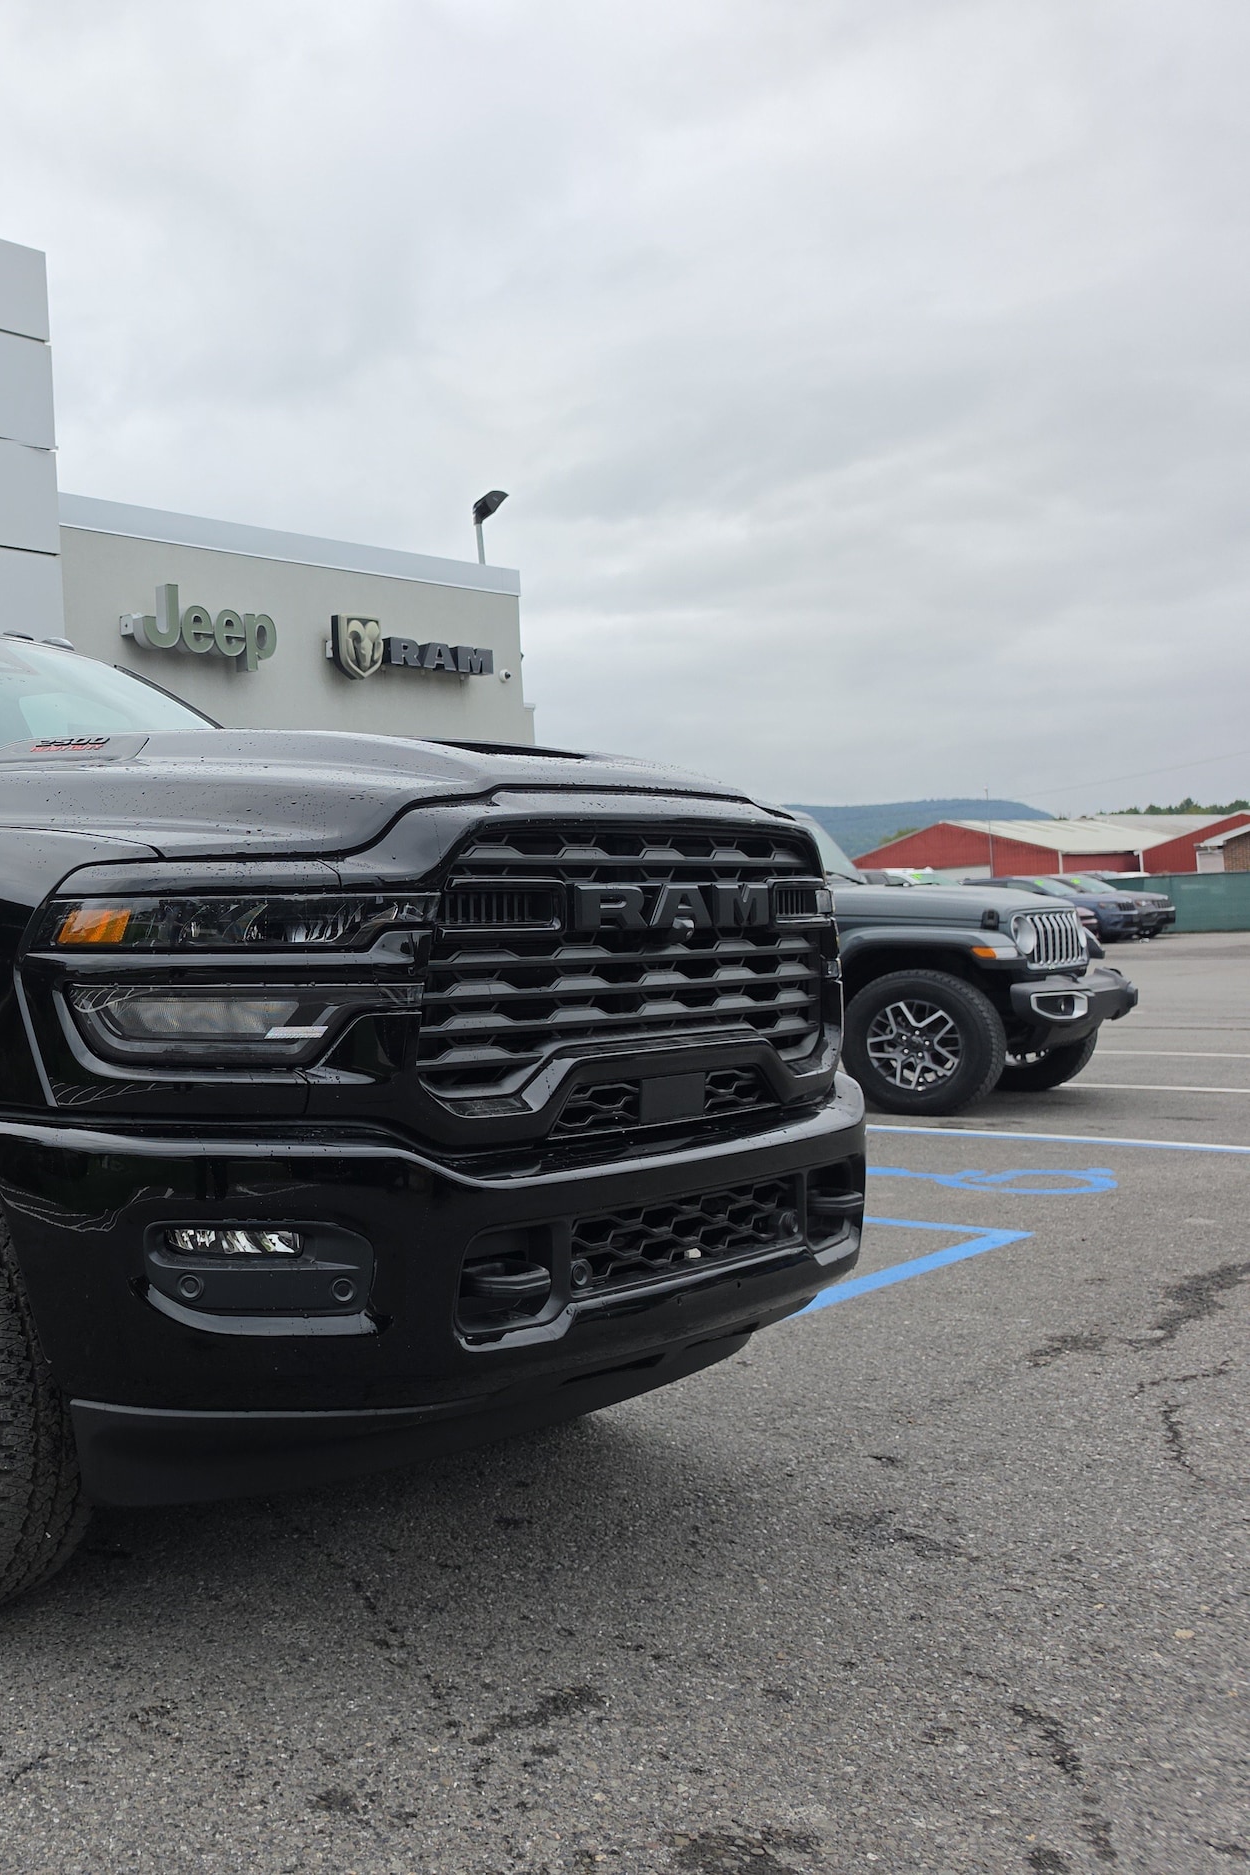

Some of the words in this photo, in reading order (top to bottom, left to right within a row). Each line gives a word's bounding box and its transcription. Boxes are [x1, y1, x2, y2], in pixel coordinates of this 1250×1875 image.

[133, 584, 277, 672] Jeep
[382, 636, 494, 676] RAM
[573, 884, 768, 930] RAM
